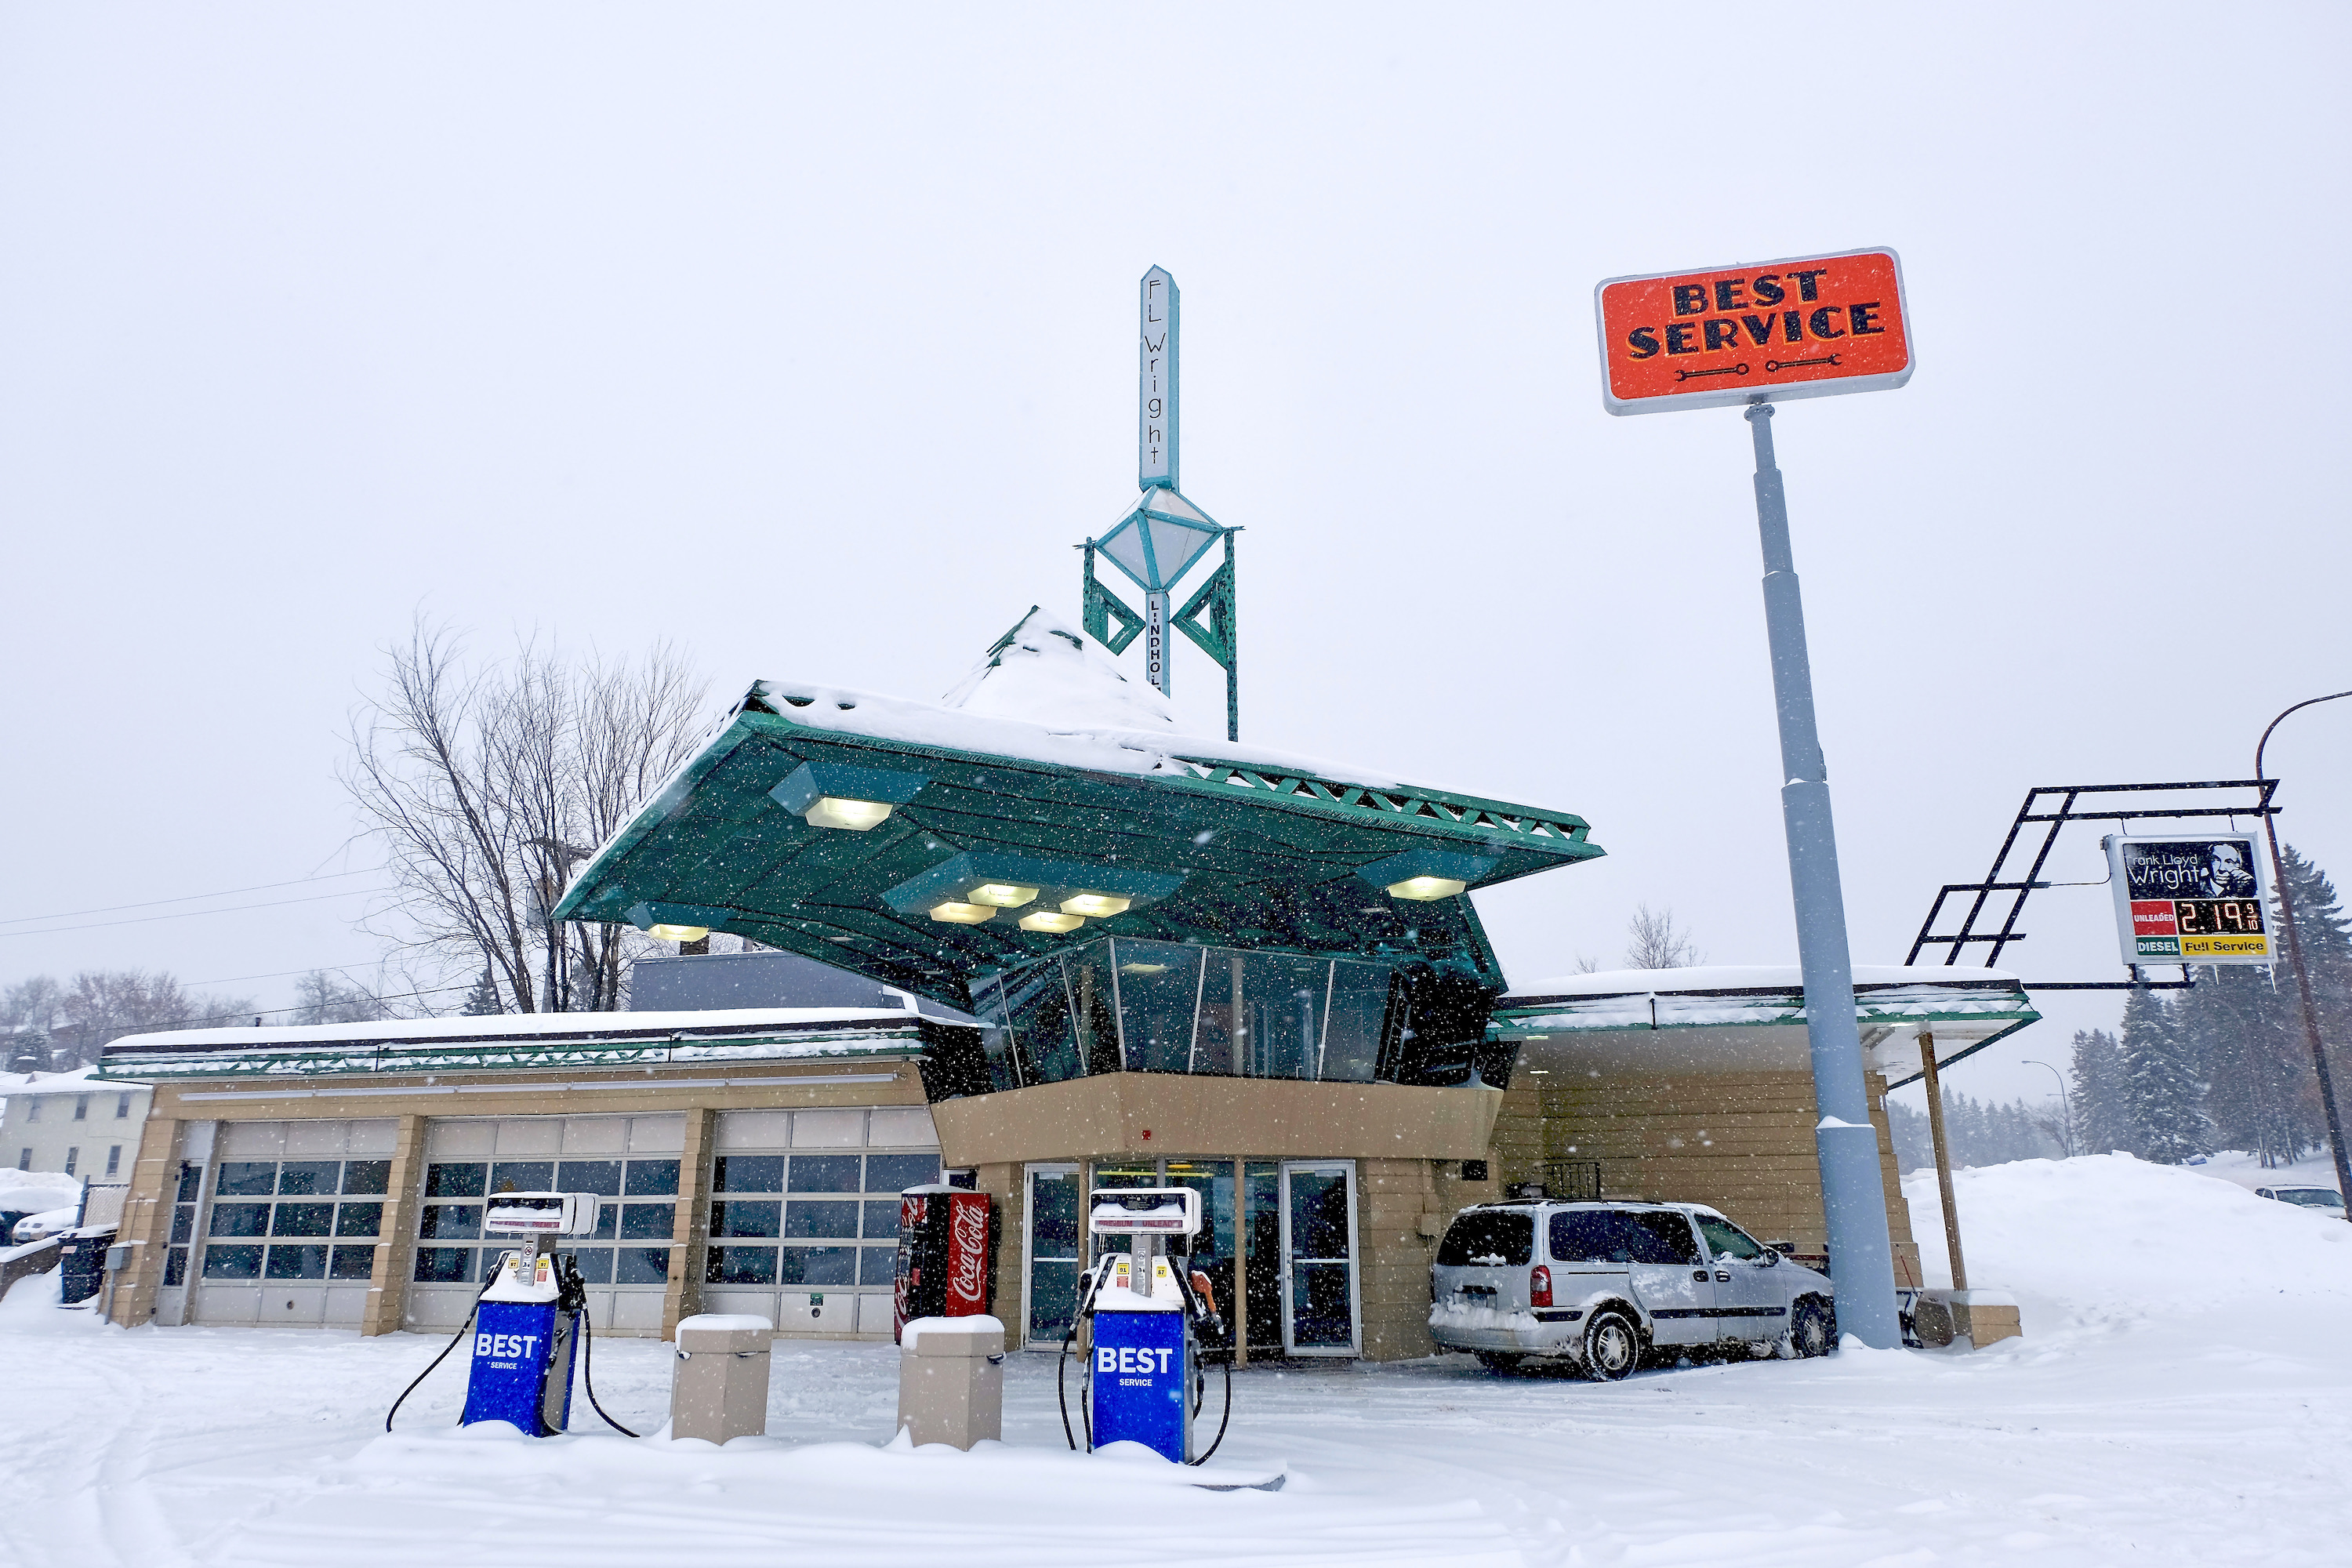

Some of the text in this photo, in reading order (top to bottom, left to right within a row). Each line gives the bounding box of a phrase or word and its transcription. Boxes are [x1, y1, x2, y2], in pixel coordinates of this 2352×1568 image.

[1672, 269, 1828, 318] BEST
[1627, 302, 1886, 362] SERVICE
[1149, 601, 1162, 691] LINDHOL
[2163, 853, 2198, 867] Lloyd
[2127, 866, 2200, 889] Wright
[2134, 913, 2175, 922] UNLEADED
[2181, 902, 2243, 931] 2.19
[2137, 942, 2180, 953] DIESEL
[2185, 941, 2265, 952] Full Service
[475, 1333, 538, 1359] BEST
[490, 1361, 517, 1370] SERVICE
[1098, 1347, 1173, 1374] BEST
[1119, 1377, 1152, 1387] SERVICE
